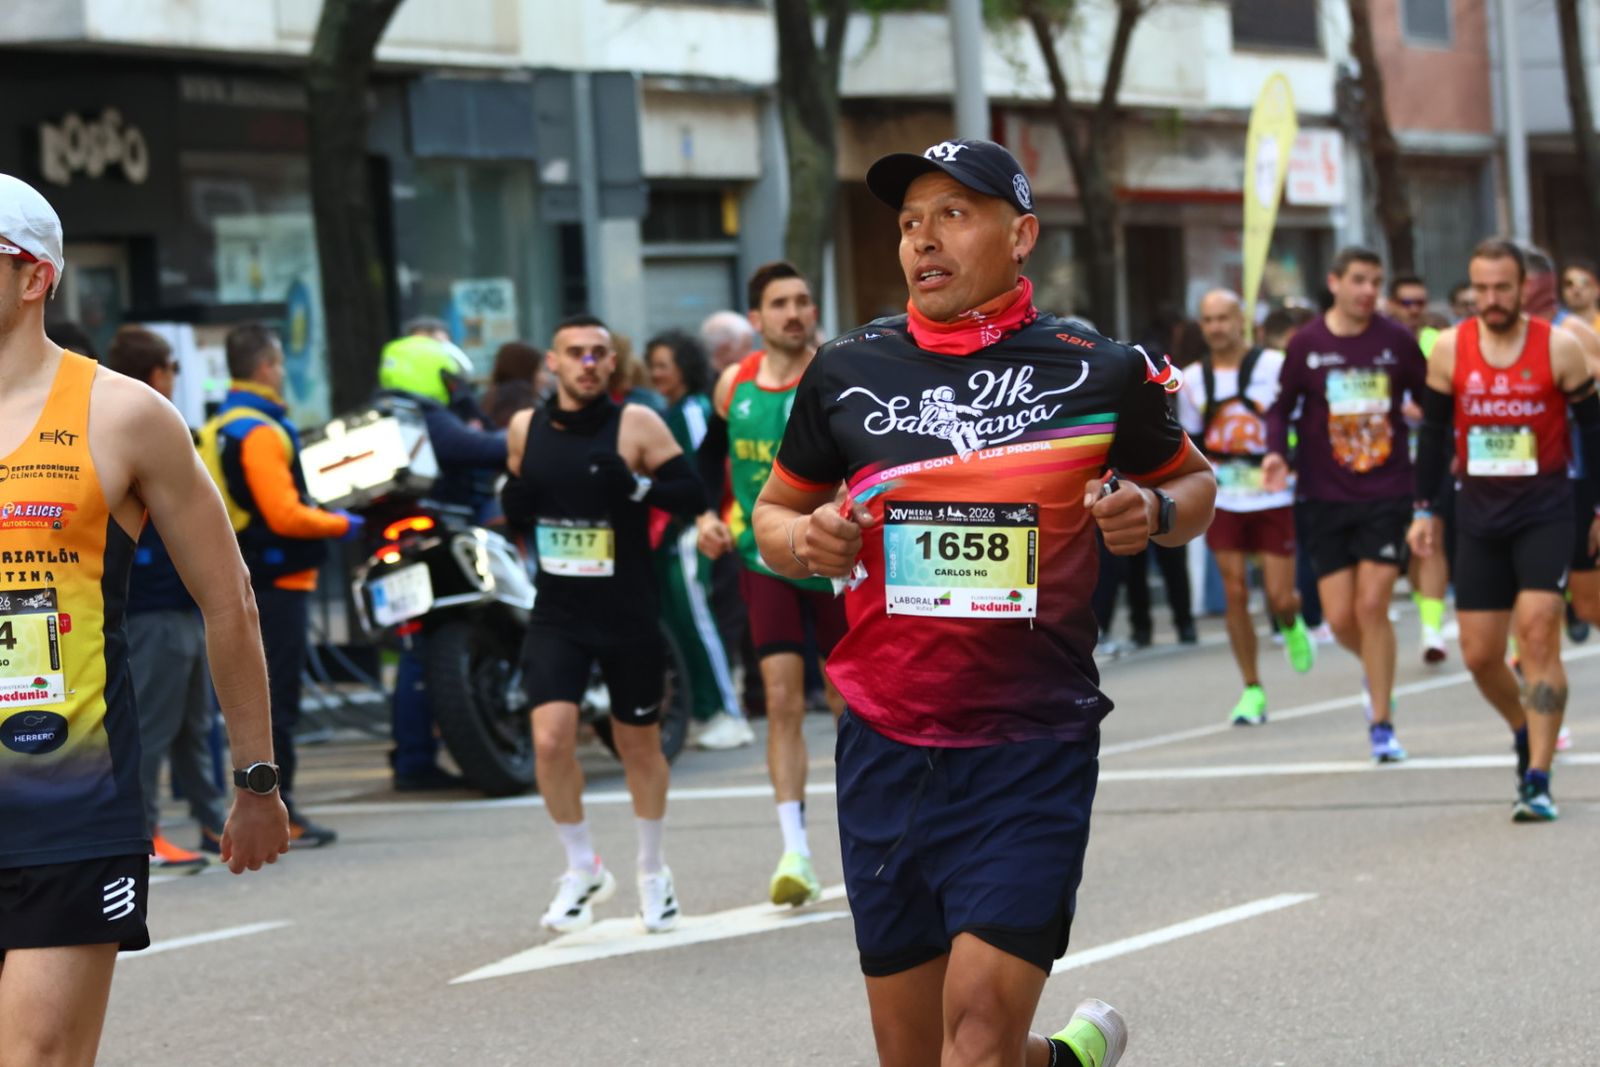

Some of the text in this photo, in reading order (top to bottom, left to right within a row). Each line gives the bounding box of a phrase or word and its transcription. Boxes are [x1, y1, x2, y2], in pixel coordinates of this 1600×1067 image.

[923, 141, 969, 162] NY
[968, 364, 1060, 410] 21k
[863, 396, 1063, 438] Salamanca
[40, 429, 79, 446] EKT
[11, 464, 35, 472] ESTER
[880, 441, 1052, 481] CORRE CON LUZ PROPIA
[10, 472, 80, 480] CLÍNICA DENTAL
[890, 509, 909, 520] XIV
[969, 507, 996, 519] 2026
[550, 532, 597, 547] 1717
[915, 531, 1010, 562] 1658
[0, 571, 54, 582] TINA
[934, 568, 988, 577] CARLOS HG
[894, 596, 932, 605] LABORAL
[971, 602, 1022, 612] bedunia
[0, 621, 17, 651] 4
[14, 733, 54, 742] HERRERO
